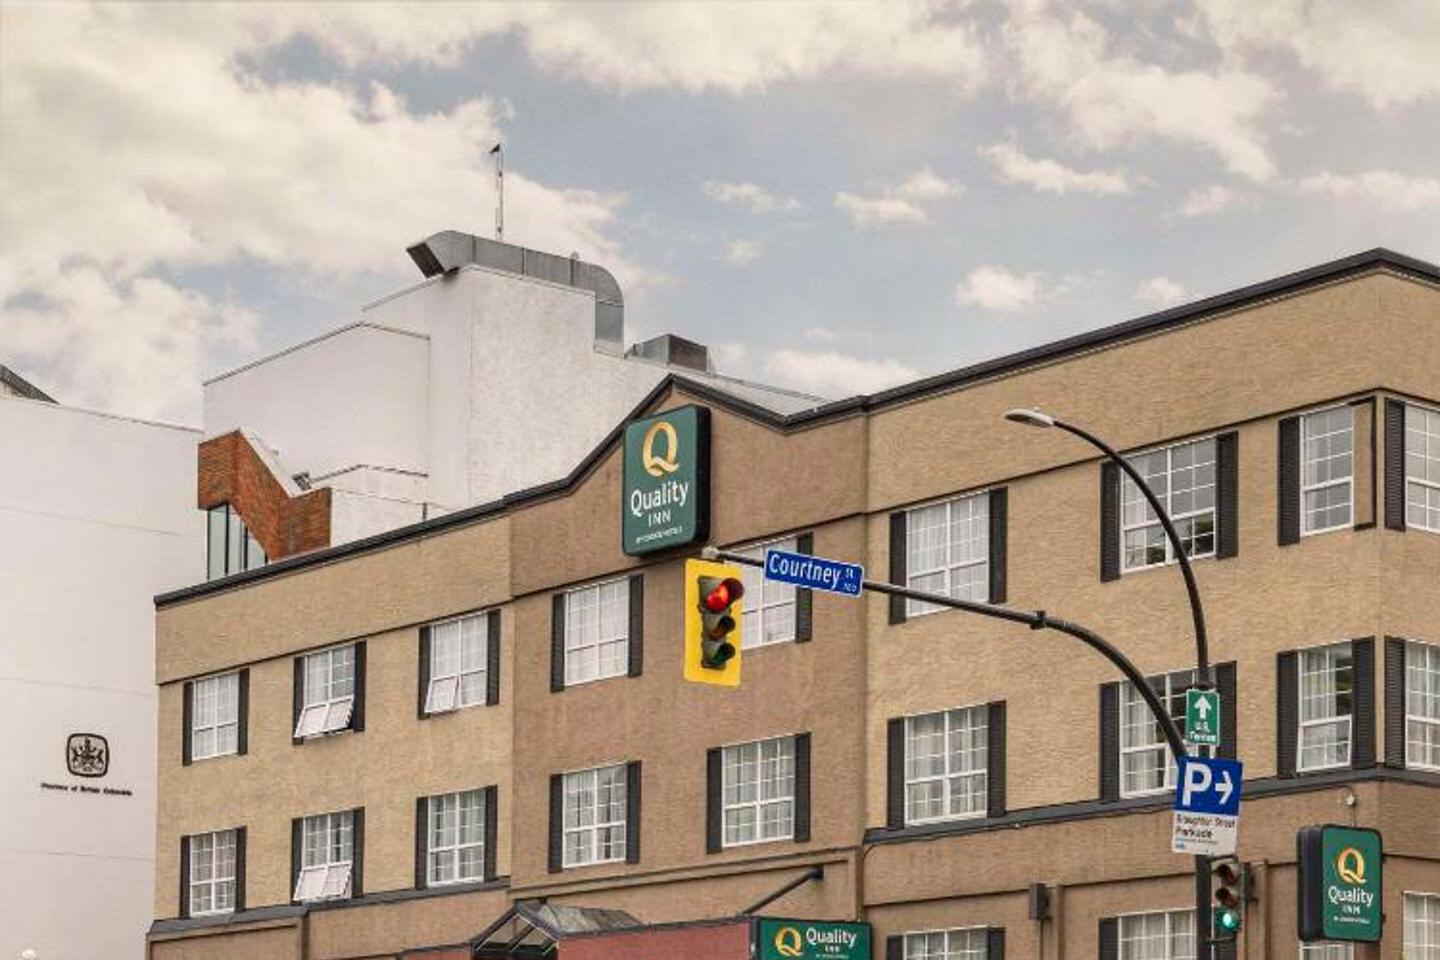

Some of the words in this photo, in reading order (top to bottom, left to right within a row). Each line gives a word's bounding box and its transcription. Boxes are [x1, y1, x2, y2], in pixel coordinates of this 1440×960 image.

[643, 421, 679, 477] Q
[631, 481, 689, 517] Quality
[648, 508, 671, 527] INN
[769, 553, 841, 590] Courtney
[1182, 761, 1212, 806] P
[1337, 847, 1366, 885] Q
[1328, 886, 1374, 908] Quality
[775, 927, 804, 957] Q
[806, 927, 857, 950] Quality
